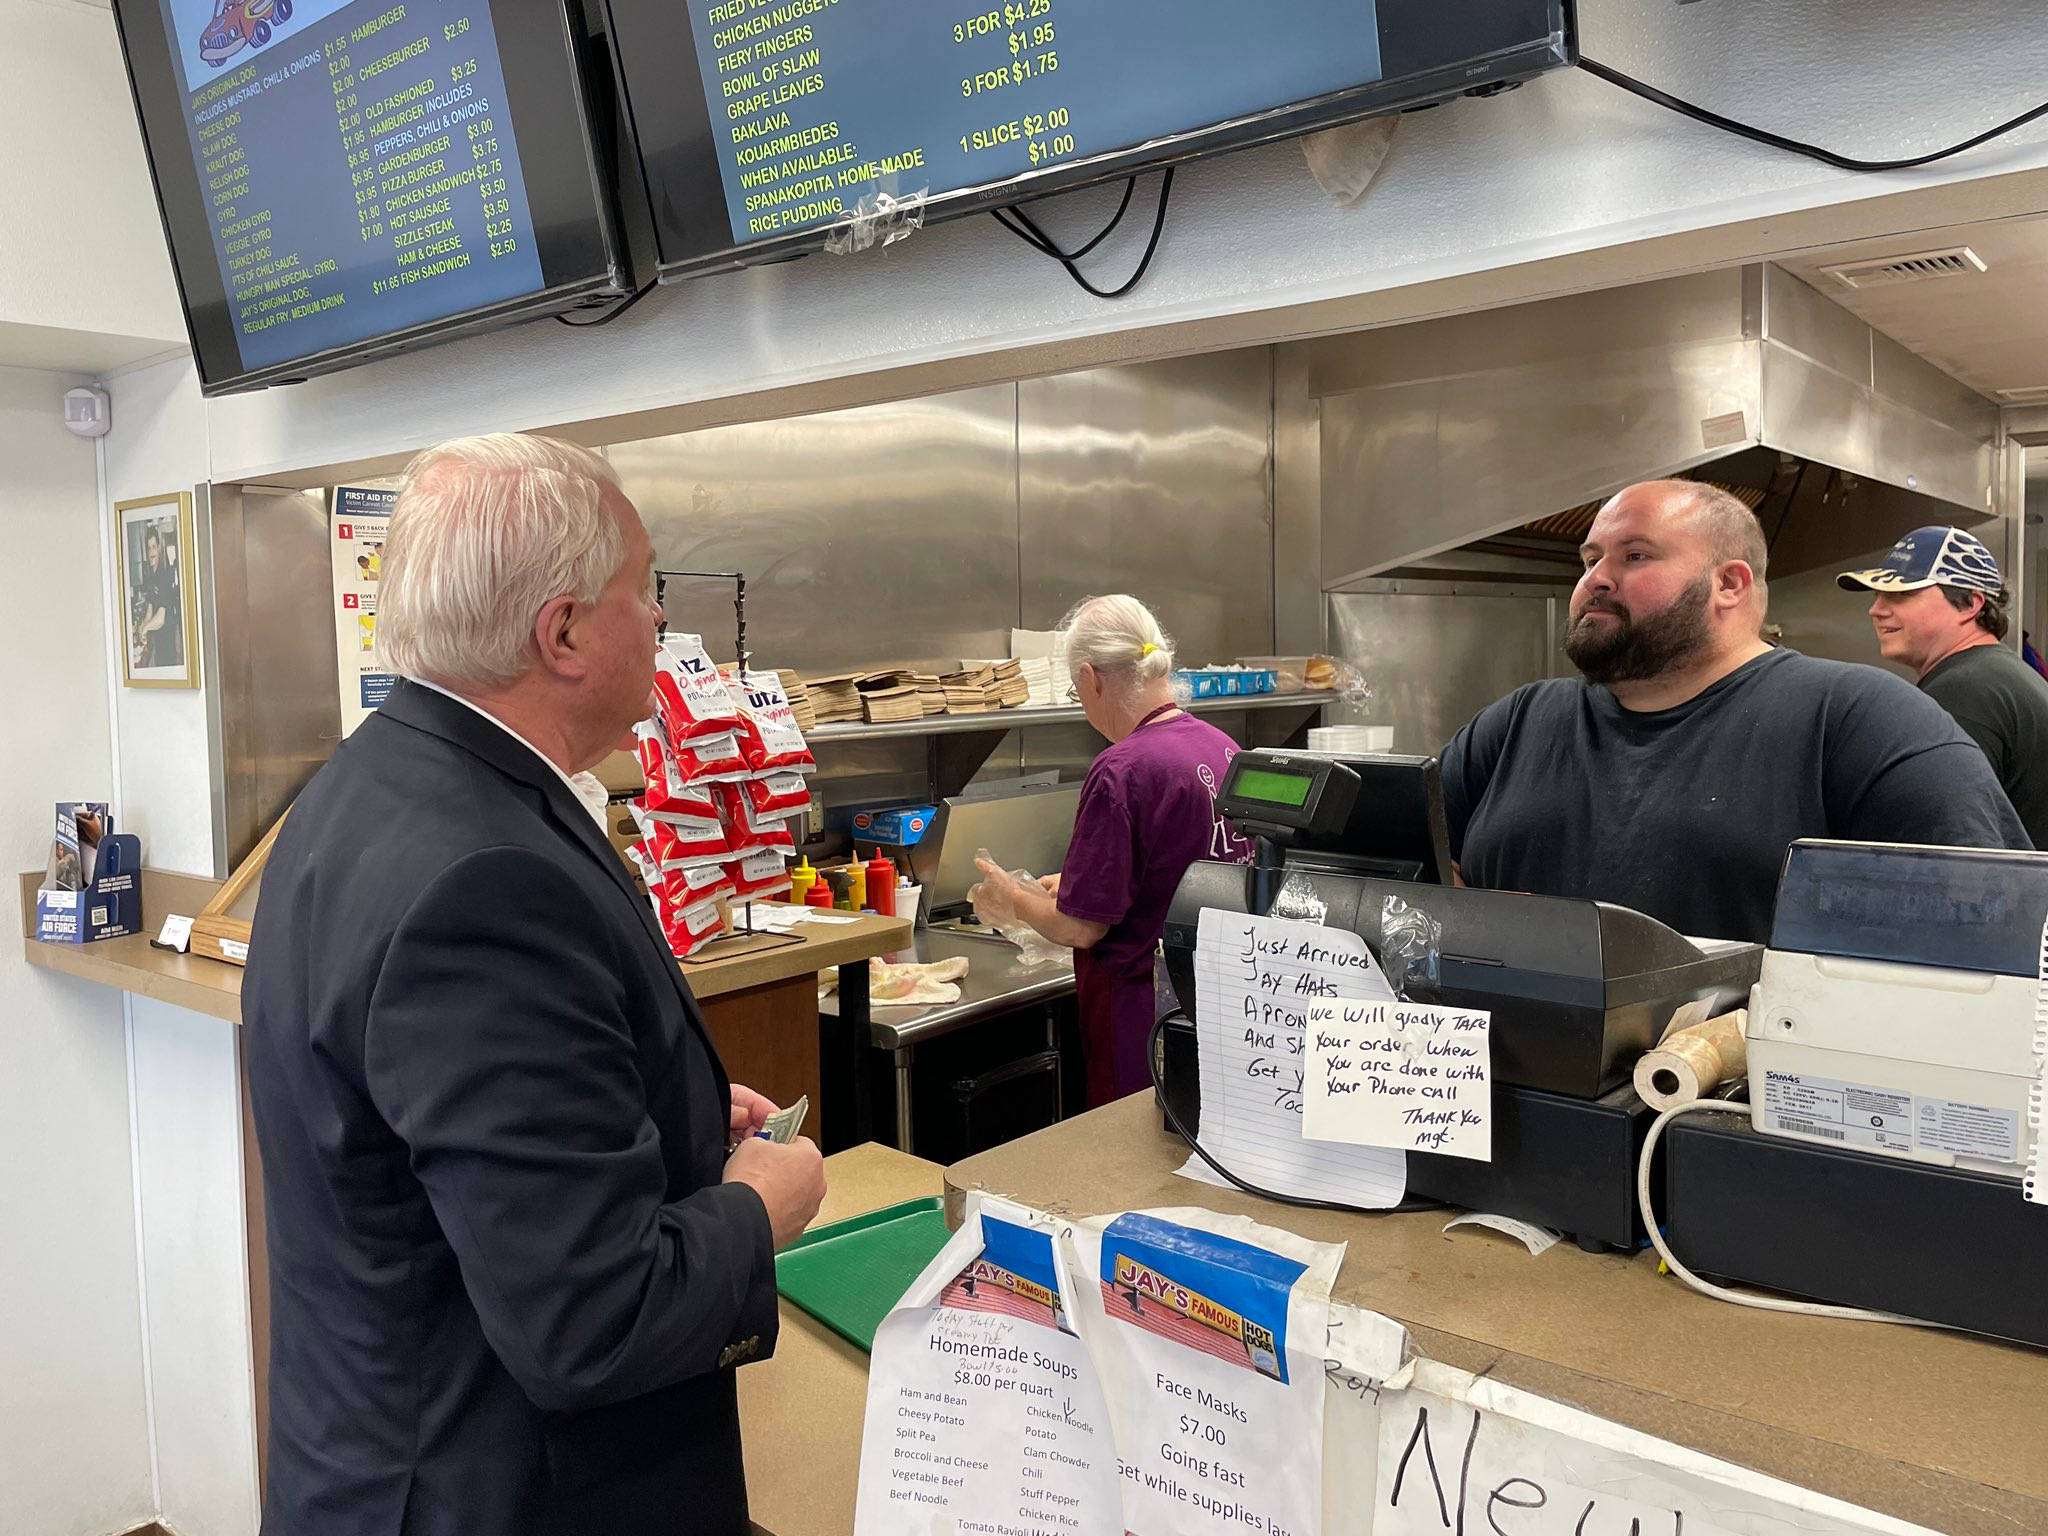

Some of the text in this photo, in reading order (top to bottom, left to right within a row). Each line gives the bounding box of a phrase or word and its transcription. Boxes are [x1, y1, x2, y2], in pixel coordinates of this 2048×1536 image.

[350, 4, 405, 42] HAMBURGER
[708, 0, 745, 25] FRIED
[953, 0, 1050, 42] 3 FOR $4.25
[443, 17, 469, 41] $2.50
[713, 13, 771, 48] CHICKEN
[1008, 22, 1054, 57] $1.95
[359, 36, 430, 80] CHEESEBURGER
[717, 24, 812, 73] FIERY FINGERS
[450, 58, 476, 82] $3.25
[722, 48, 819, 97] BOWL OF SLAW
[961, 51, 1057, 97] 3 FOR $1.75
[365, 78, 434, 119] OLD FASHIONED
[727, 73, 823, 119] GRAPE LEAVES
[369, 82, 472, 137] HAMBURGER INCLUDES
[416, 118, 441, 138] CHILI
[442, 114, 450, 128] &
[450, 97, 488, 123] ONIONS
[467, 118, 492, 141] $3.00
[731, 111, 790, 143] BAKLAVA
[959, 107, 1068, 152] 1 SLICE $2.00
[378, 135, 450, 174] GARDENBURGER
[471, 137, 498, 160] $3.75
[736, 121, 838, 165] KOUARMBIEDES
[1028, 134, 1074, 165] $1.00
[381, 159, 445, 193] PIZZA BURGER
[476, 158, 502, 180] $2.75
[740, 142, 857, 189] WHEN AVAILABLE:
[385, 168, 475, 212] CHICKEN SANDWICH
[479, 178, 505, 200] $3.50
[745, 148, 924, 211] SPANAKOPITA HOME MADE
[978, 184, 1018, 200] INSIGNIA
[389, 197, 451, 229] HOT SAUSAGE
[483, 198, 509, 219] $3.50
[749, 196, 842, 234] RICE PUDDING
[393, 217, 454, 248] SIZZLE STEAK
[486, 218, 512, 240] $2.25
[396, 234, 462, 266] HAM & CHEESE
[490, 238, 516, 259] $2.50
[400, 252, 470, 285] FISH SANDWICH
[372, 275, 399, 295] $11.65
[345, 492, 380, 502] FIRST AID
[343, 526, 349, 536] 1
[347, 596, 354, 606] 2
[1241, 927, 1370, 969] Just Arrived
[1311, 1008, 1335, 1020] We
[1395, 1013, 1445, 1033] gladly
[1245, 1028, 1275, 1048] And
[1359, 1038, 1412, 1051] order
[1248, 1058, 1280, 1078] Get
[1361, 1061, 1393, 1071] are
[1400, 1059, 1438, 1077] done
[1446, 1065, 1484, 1080] with
[1368, 1076, 1415, 1095] Phone
[1016, 1280, 1050, 1301] FAMOUS
[1121, 1264, 1238, 1332] JAY'S FAMOUS
[1246, 1322, 1270, 1340] HOT
[1246, 1335, 1273, 1354] DOGS
[930, 1335, 1028, 1363] Homemade
[1034, 1352, 1078, 1380] Soups
[901, 1387, 967, 1406] Ham and Bean
[954, 1370, 1053, 1398] $8.00 per quart
[1157, 1373, 1247, 1423] Face Masks
[899, 1407, 965, 1425] Cheesy Potato
[1027, 1406, 1094, 1434] Chicken Noodle
[896, 1428, 936, 1441] Split Pea
[1025, 1426, 1057, 1440] Potato
[1180, 1414, 1226, 1445] $7.00
[895, 1448, 988, 1470] Broccoli and Cheese
[1024, 1447, 1090, 1469] Clam Chowder
[1161, 1444, 1246, 1489] Going fast
[892, 1469, 964, 1487] Vegetable Beef
[1022, 1467, 1042, 1478] Chili
[890, 1490, 948, 1505] Beef Noodle
[1020, 1487, 1080, 1506] Stuff Pepper
[1145, 1475, 1186, 1501] while
[1192, 1492, 1262, 1530] supplies
[1268, 1518, 1291, 1536] las
[958, 1519, 995, 1533] Tomato
[998, 1525, 1029, 1536] Ravioli
[1020, 1508, 1079, 1527] Chicken Rice
